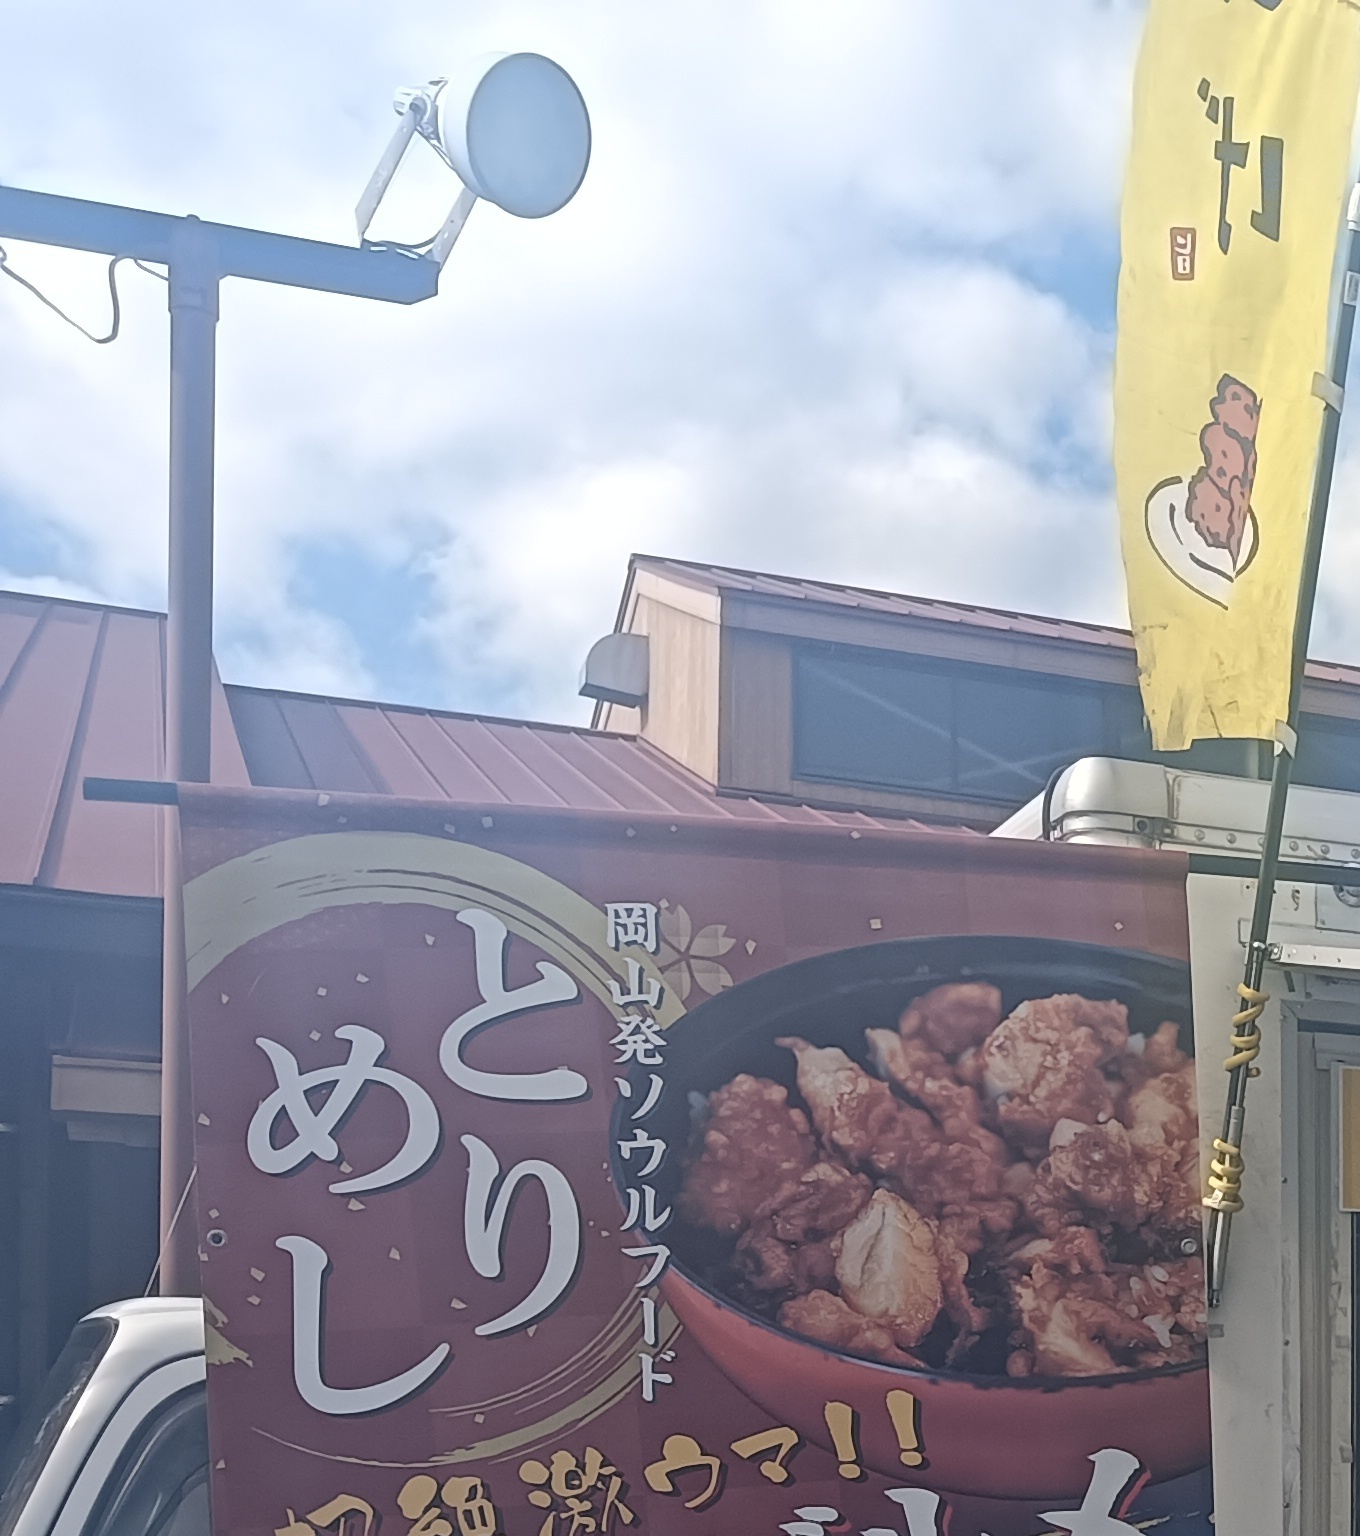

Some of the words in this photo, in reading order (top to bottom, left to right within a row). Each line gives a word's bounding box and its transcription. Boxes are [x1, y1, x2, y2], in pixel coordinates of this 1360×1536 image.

[247, 1023, 451, 1416] めし
[439, 908, 588, 1337] とり
[604, 901, 674, 1403] 岡山発ソウルフード
